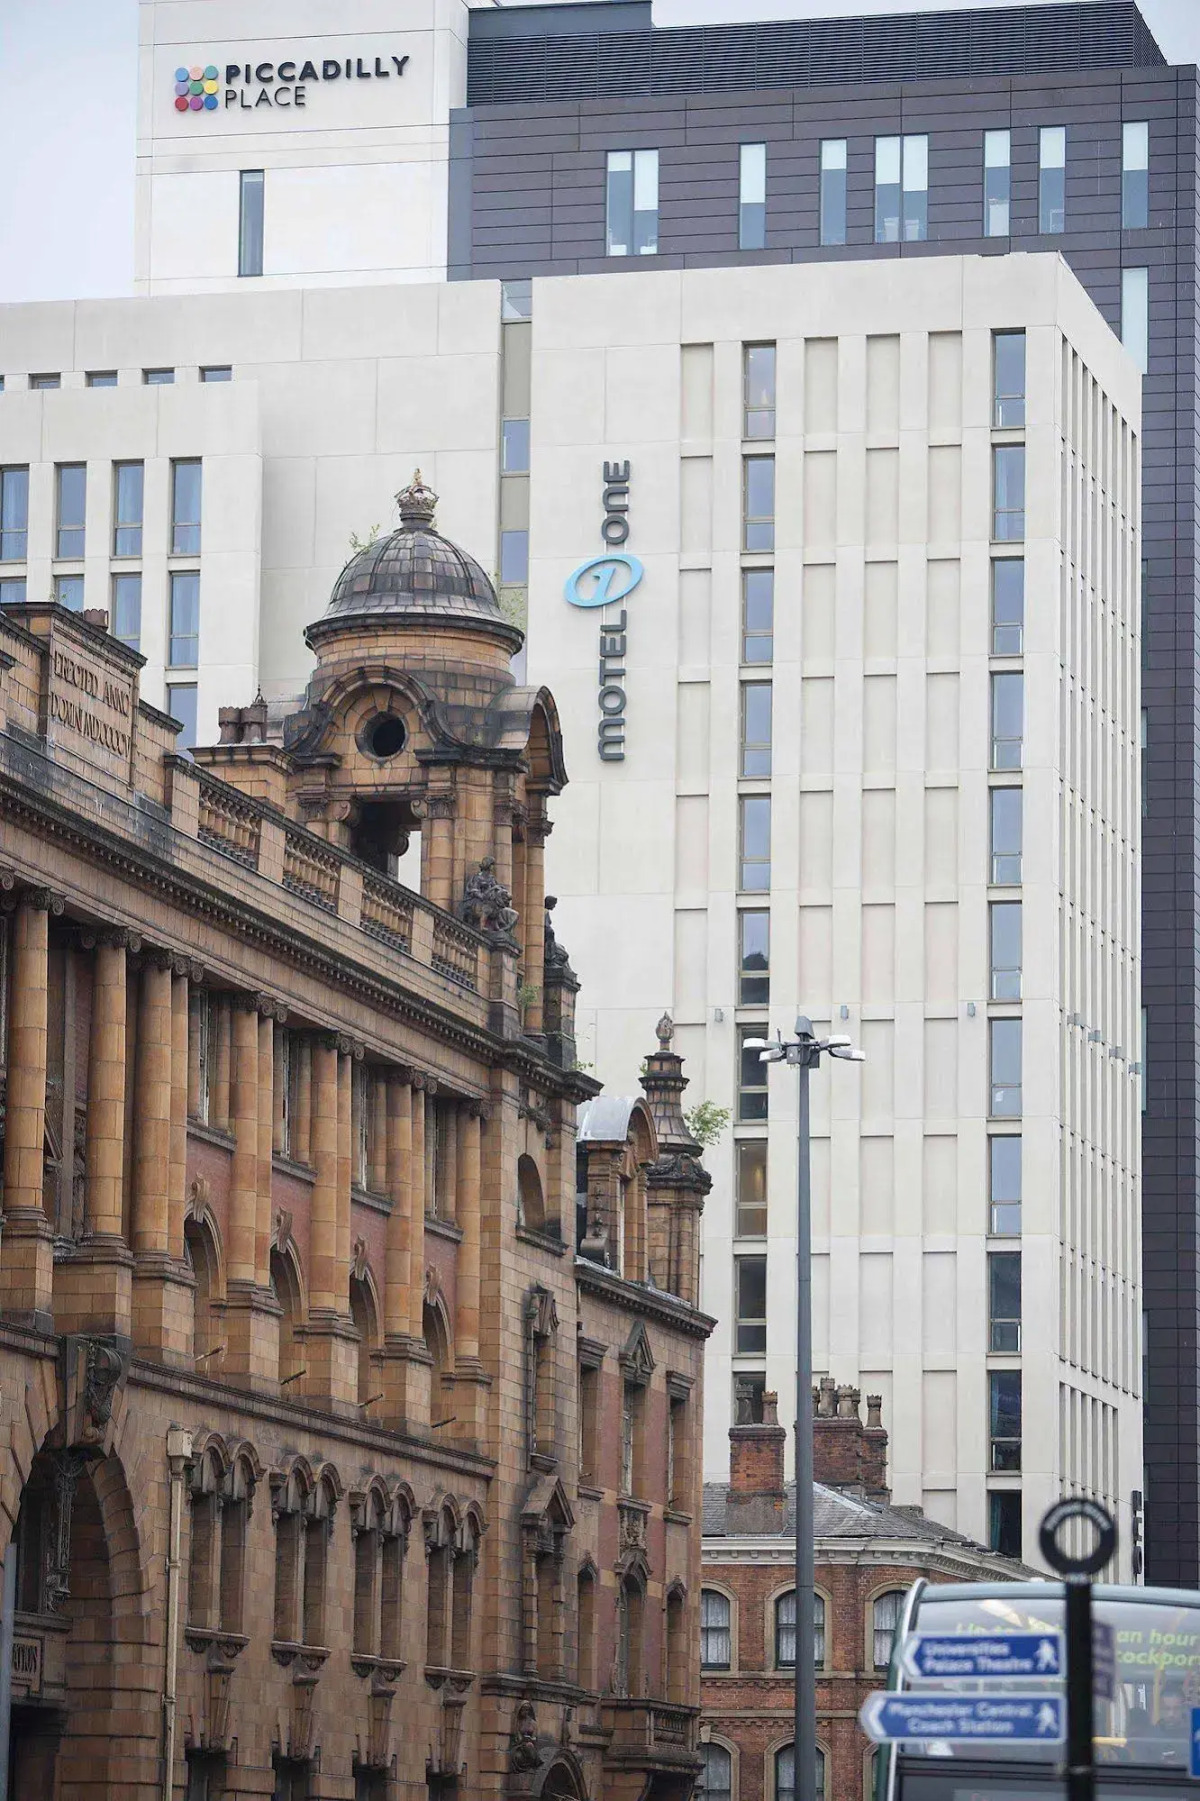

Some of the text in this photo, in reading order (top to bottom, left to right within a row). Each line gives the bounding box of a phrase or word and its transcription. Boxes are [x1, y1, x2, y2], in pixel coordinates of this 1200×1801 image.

[225, 55, 410, 85] PICCADILLY
[225, 86, 306, 109] PLACE
[54, 650, 130, 718] ERECTED ANNO
[1117, 1628, 1198, 1646] an hour
[958, 1717, 1015, 1734] Station
